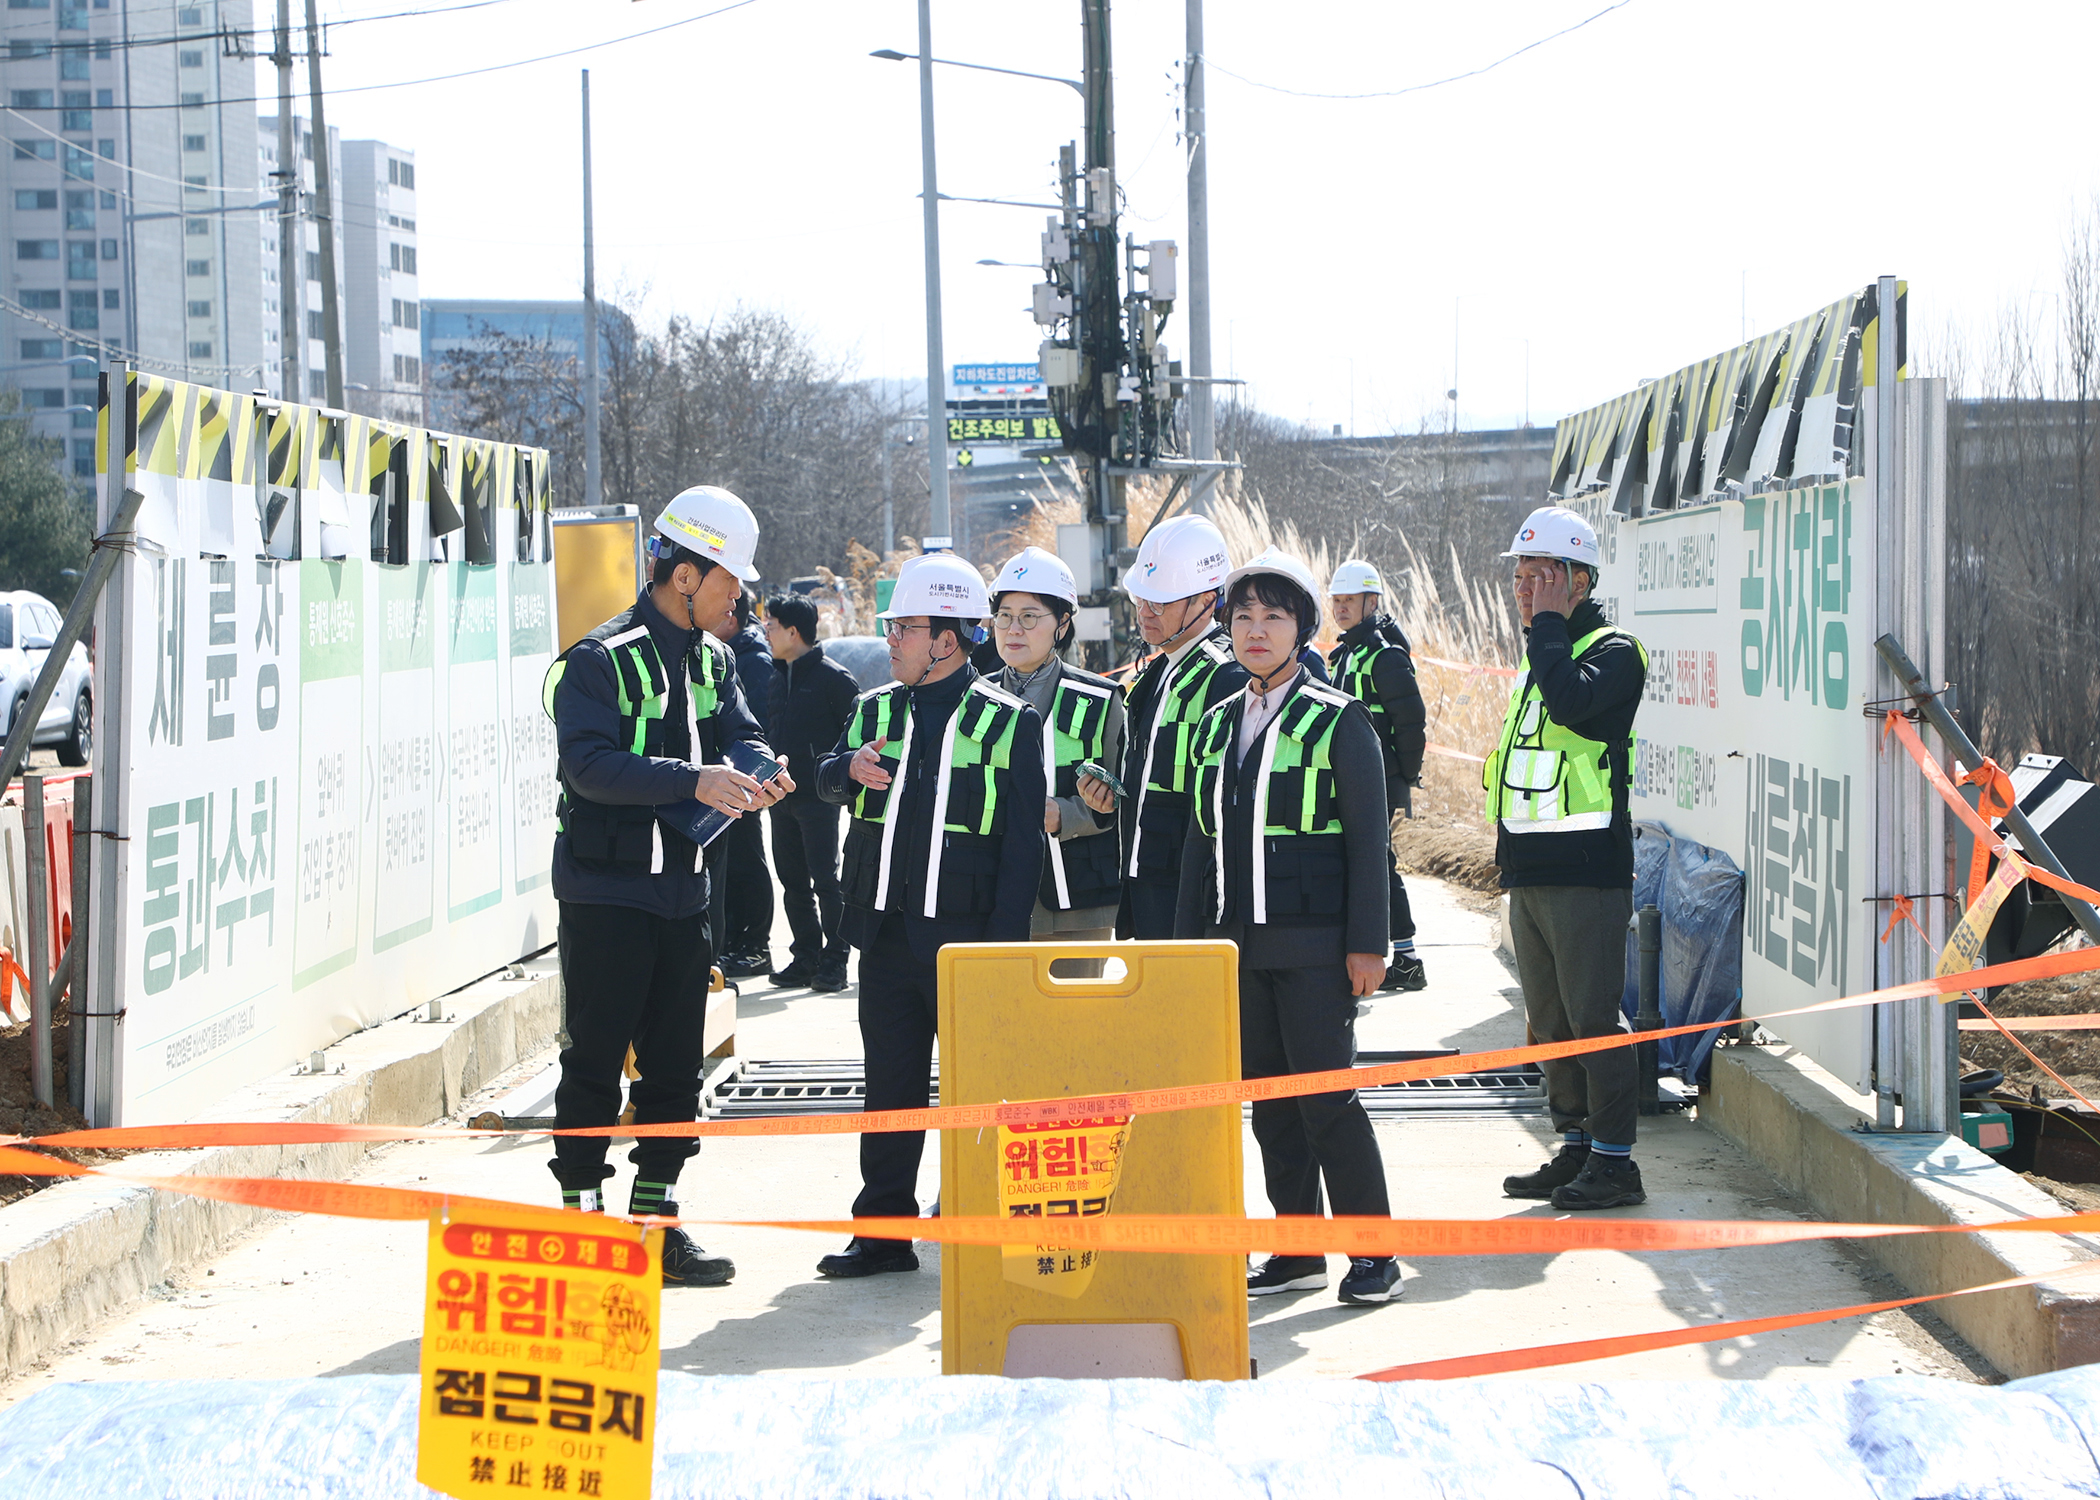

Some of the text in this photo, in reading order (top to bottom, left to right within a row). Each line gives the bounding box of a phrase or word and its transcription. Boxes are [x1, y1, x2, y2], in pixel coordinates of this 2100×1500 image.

[949, 419, 1025, 440] 건조주의보
[687, 516, 728, 541] 건설사업관리단
[929, 583, 970, 595] 서울특별시
[1638, 532, 1716, 592] 현장 내 10km 서행하십시오
[330, 599, 355, 645] 신호준수
[1740, 485, 1852, 711] 공사차량
[1677, 649, 1719, 708] 천천히 서행!
[317, 749, 346, 819] 앞바퀴
[382, 731, 431, 801] 앞바퀴 세륜 후
[1669, 746, 1675, 799] 더
[385, 805, 426, 874] 뒷바퀴 진입
[458, 786, 492, 849] 움직입니다
[143, 776, 279, 997] 통과수칙
[302, 824, 356, 904] 진입 후 정지
[1745, 752, 1850, 999] 세륜철저
[896, 1112, 929, 1127] SAFETY
[931, 1111, 948, 1125] LINE
[953, 1109, 991, 1124] 접근금지
[1041, 1107, 1057, 1115] WBK
[1068, 1100, 1105, 1115] 안전제일
[1108, 1097, 1146, 1111] 추락주의
[1150, 1094, 1187, 1108] 안전제일
[1190, 1089, 1227, 1104] 추락주의
[1235, 1085, 1272, 1098] 난연제품
[1279, 1080, 1309, 1093] SAFETY
[1311, 1077, 1328, 1090] LINE
[1333, 1073, 1370, 1088] 접근금지
[1004, 1136, 1088, 1181] 위험!
[1007, 1181, 1062, 1196] DANGER!
[470, 1231, 630, 1270] 안전 제일
[1115, 1223, 1165, 1244] SAFETY
[1170, 1224, 1199, 1244] LINE
[1400, 1226, 1463, 1246] 안전제일
[1470, 1226, 1533, 1246] 추락주의
[1542, 1226, 1606, 1246] 안전제일
[436, 1268, 567, 1340] 위험!
[435, 1335, 521, 1359] DANGER!
[434, 1368, 646, 1443] 접근금지
[470, 1430, 608, 1462] KEEP OUT
[469, 1455, 604, 1499] 禁止接近
